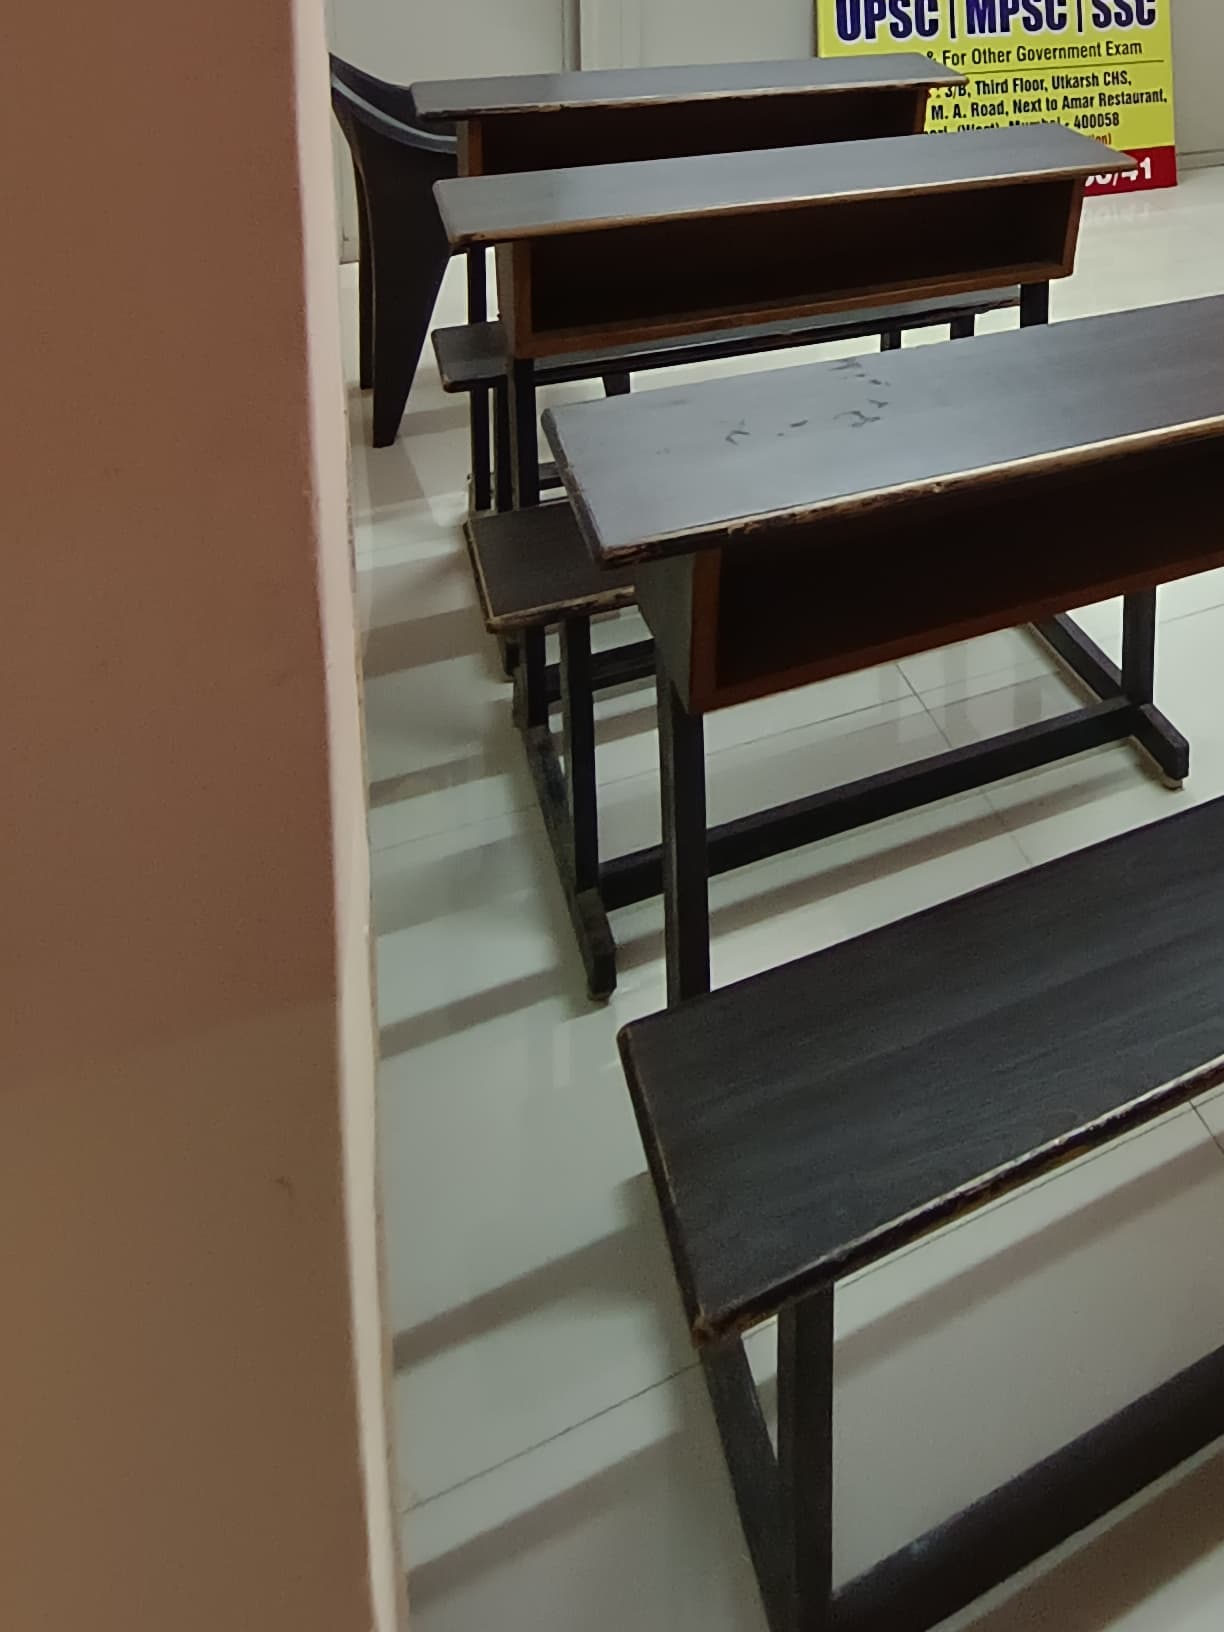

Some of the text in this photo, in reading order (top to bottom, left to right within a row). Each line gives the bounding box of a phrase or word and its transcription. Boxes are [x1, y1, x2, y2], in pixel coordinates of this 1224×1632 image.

[942, 49, 967, 66] For
[972, 47, 1011, 65] Other
[1016, 42, 1101, 63] Government
[1105, 40, 1142, 57] Exam
[975, 79, 1009, 96] Third
[1012, 76, 1049, 94] Floor,
[1051, 71, 1099, 90] Utkarsh
[1103, 70, 1132, 87] CHS,
[931, 105, 948, 120] M.
[952, 104, 967, 119] A.
[971, 102, 1009, 118] Road,
[1013, 98, 1042, 114] Next
[1046, 97, 1058, 112] to
[1062, 94, 1095, 110] Amar
[1073, 112, 1120, 129] 400058
